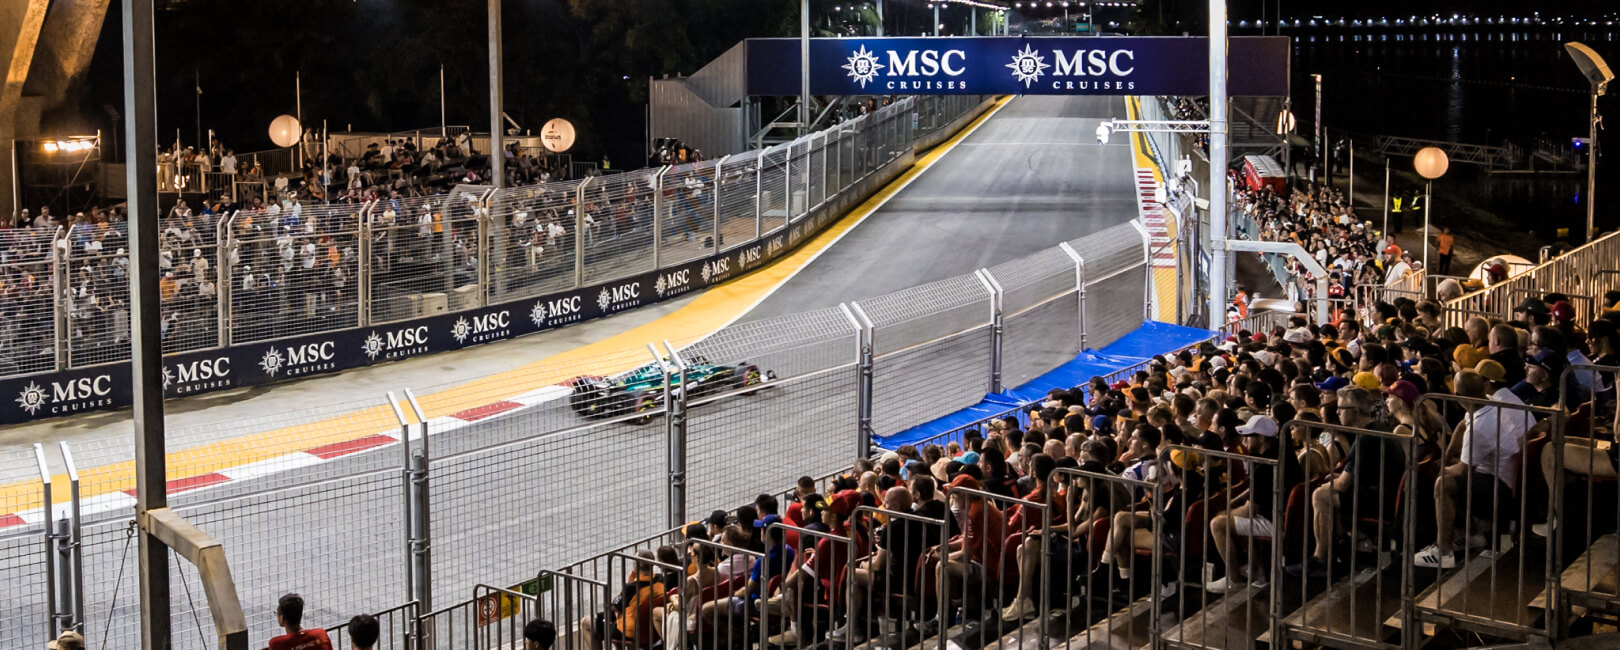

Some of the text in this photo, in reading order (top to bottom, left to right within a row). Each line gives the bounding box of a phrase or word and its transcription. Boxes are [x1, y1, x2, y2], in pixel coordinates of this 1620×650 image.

[886, 50, 966, 76] MSC
[1052, 49, 1135, 76] MSC
[886, 81, 967, 89] CRUISES
[1052, 81, 1136, 89] CRUISES
[746, 245, 761, 263] MSC
[711, 256, 730, 276] MSC
[667, 269, 690, 289] MSC
[612, 282, 640, 304] MSC
[548, 295, 581, 318] MSC
[472, 310, 510, 334] MSC
[548, 314, 581, 326] CRUISES
[386, 326, 428, 350] MSC
[472, 330, 511, 343] CRUISES
[287, 341, 334, 366] MSC
[386, 346, 428, 359] CRUISES
[177, 357, 230, 383] MSC
[287, 362, 335, 376] CRUISES
[51, 374, 111, 403] MSC
[177, 379, 231, 394] CRUISES
[51, 397, 112, 414] CRUISES
